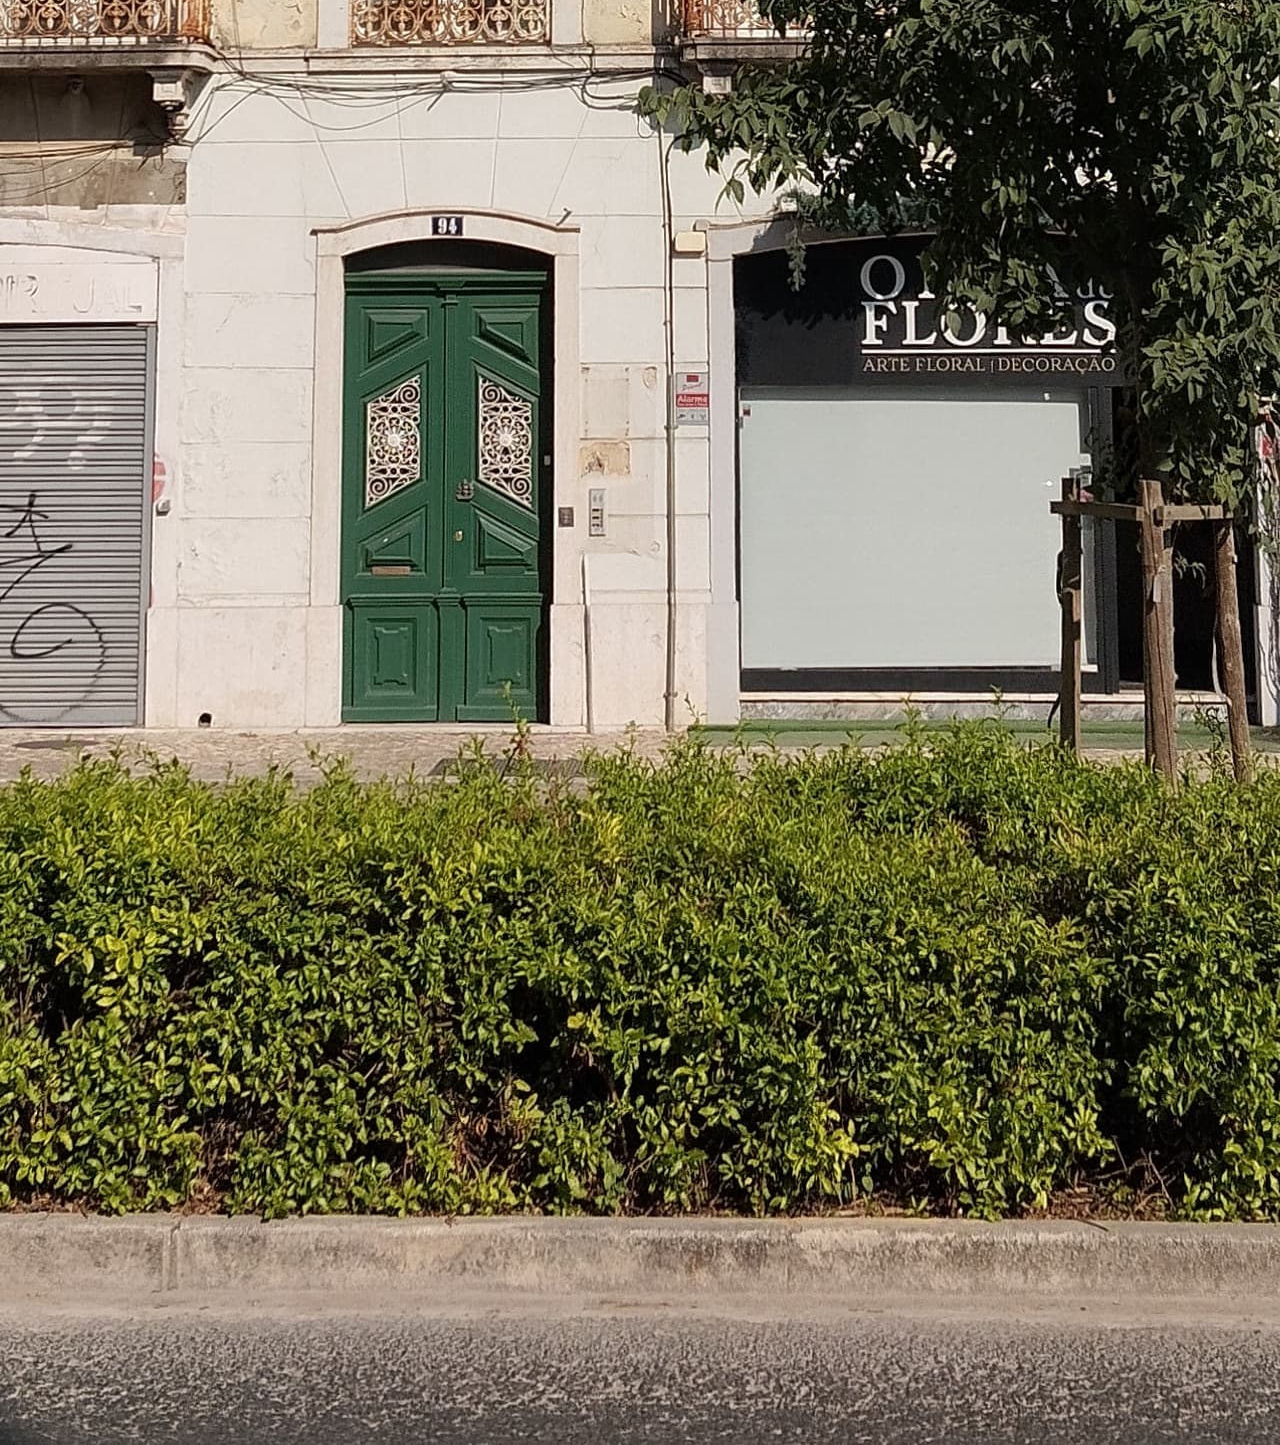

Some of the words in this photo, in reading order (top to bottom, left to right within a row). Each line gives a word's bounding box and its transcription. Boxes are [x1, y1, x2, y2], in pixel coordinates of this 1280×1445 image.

[437, 217, 458, 235] 94
[860, 255, 905, 300] O
[863, 358, 910, 372] ARTE
[915, 357, 986, 372] FLORAL
[998, 354, 1116, 374] DECORAÇÃO
